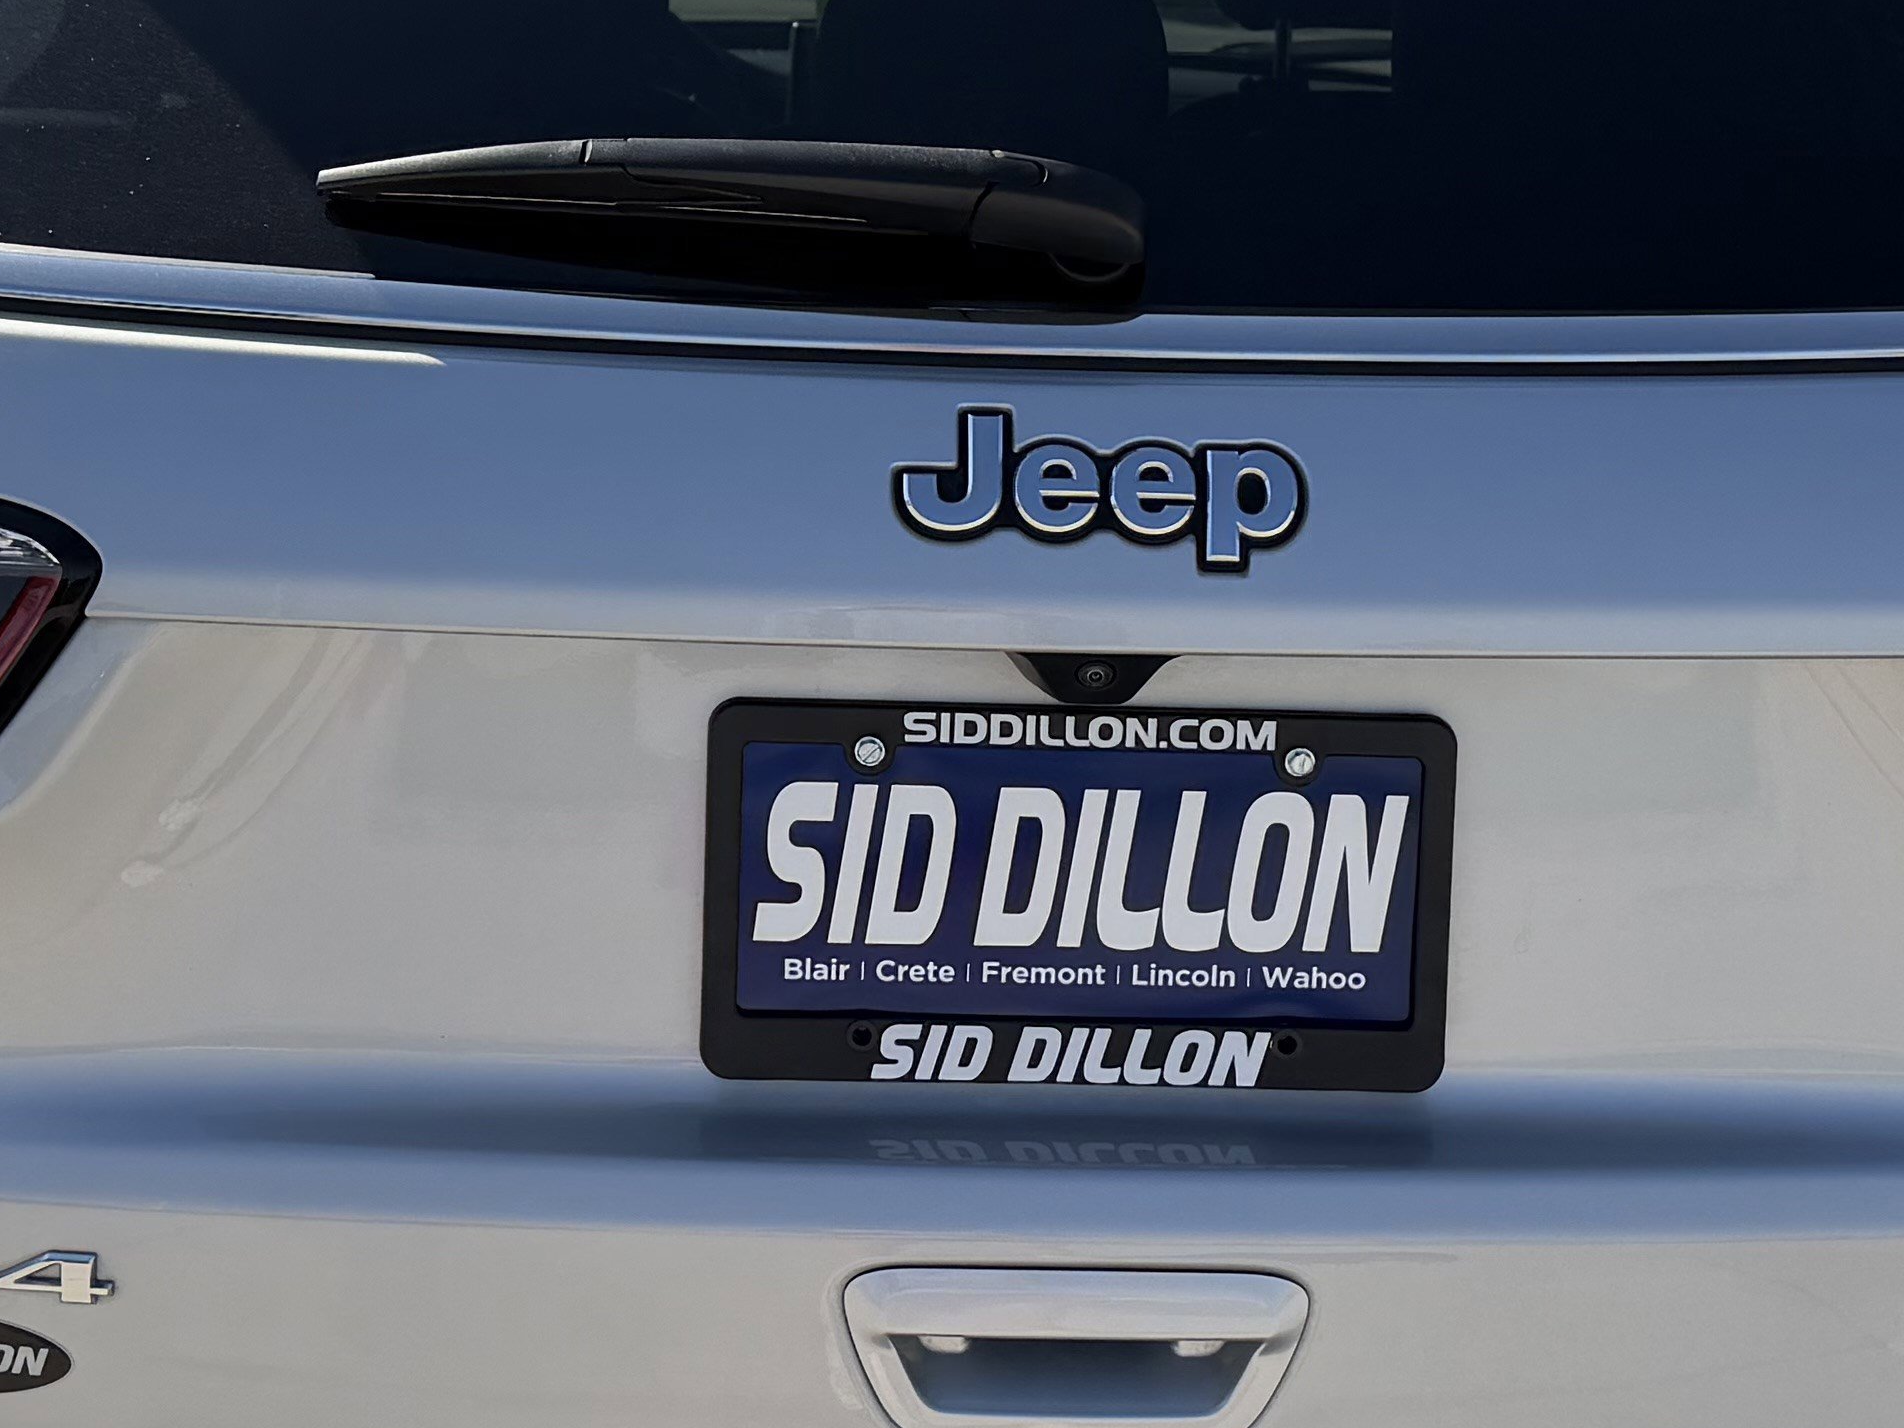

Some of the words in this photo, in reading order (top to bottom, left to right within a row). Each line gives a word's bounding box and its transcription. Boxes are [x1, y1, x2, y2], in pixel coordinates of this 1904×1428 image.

[892, 403, 1309, 575] Jeep
[903, 711, 1276, 752] SIDDILLON.COM
[752, 780, 957, 946] SID
[974, 786, 1410, 953] DILLON
[783, 956, 850, 982] Blair
[875, 959, 956, 984] Crete
[981, 960, 1106, 986] Fremont
[1131, 963, 1236, 989] Lincoln
[1262, 966, 1367, 991] Wahoo
[870, 1023, 994, 1081] SID
[1007, 1026, 1273, 1088] DILLON
